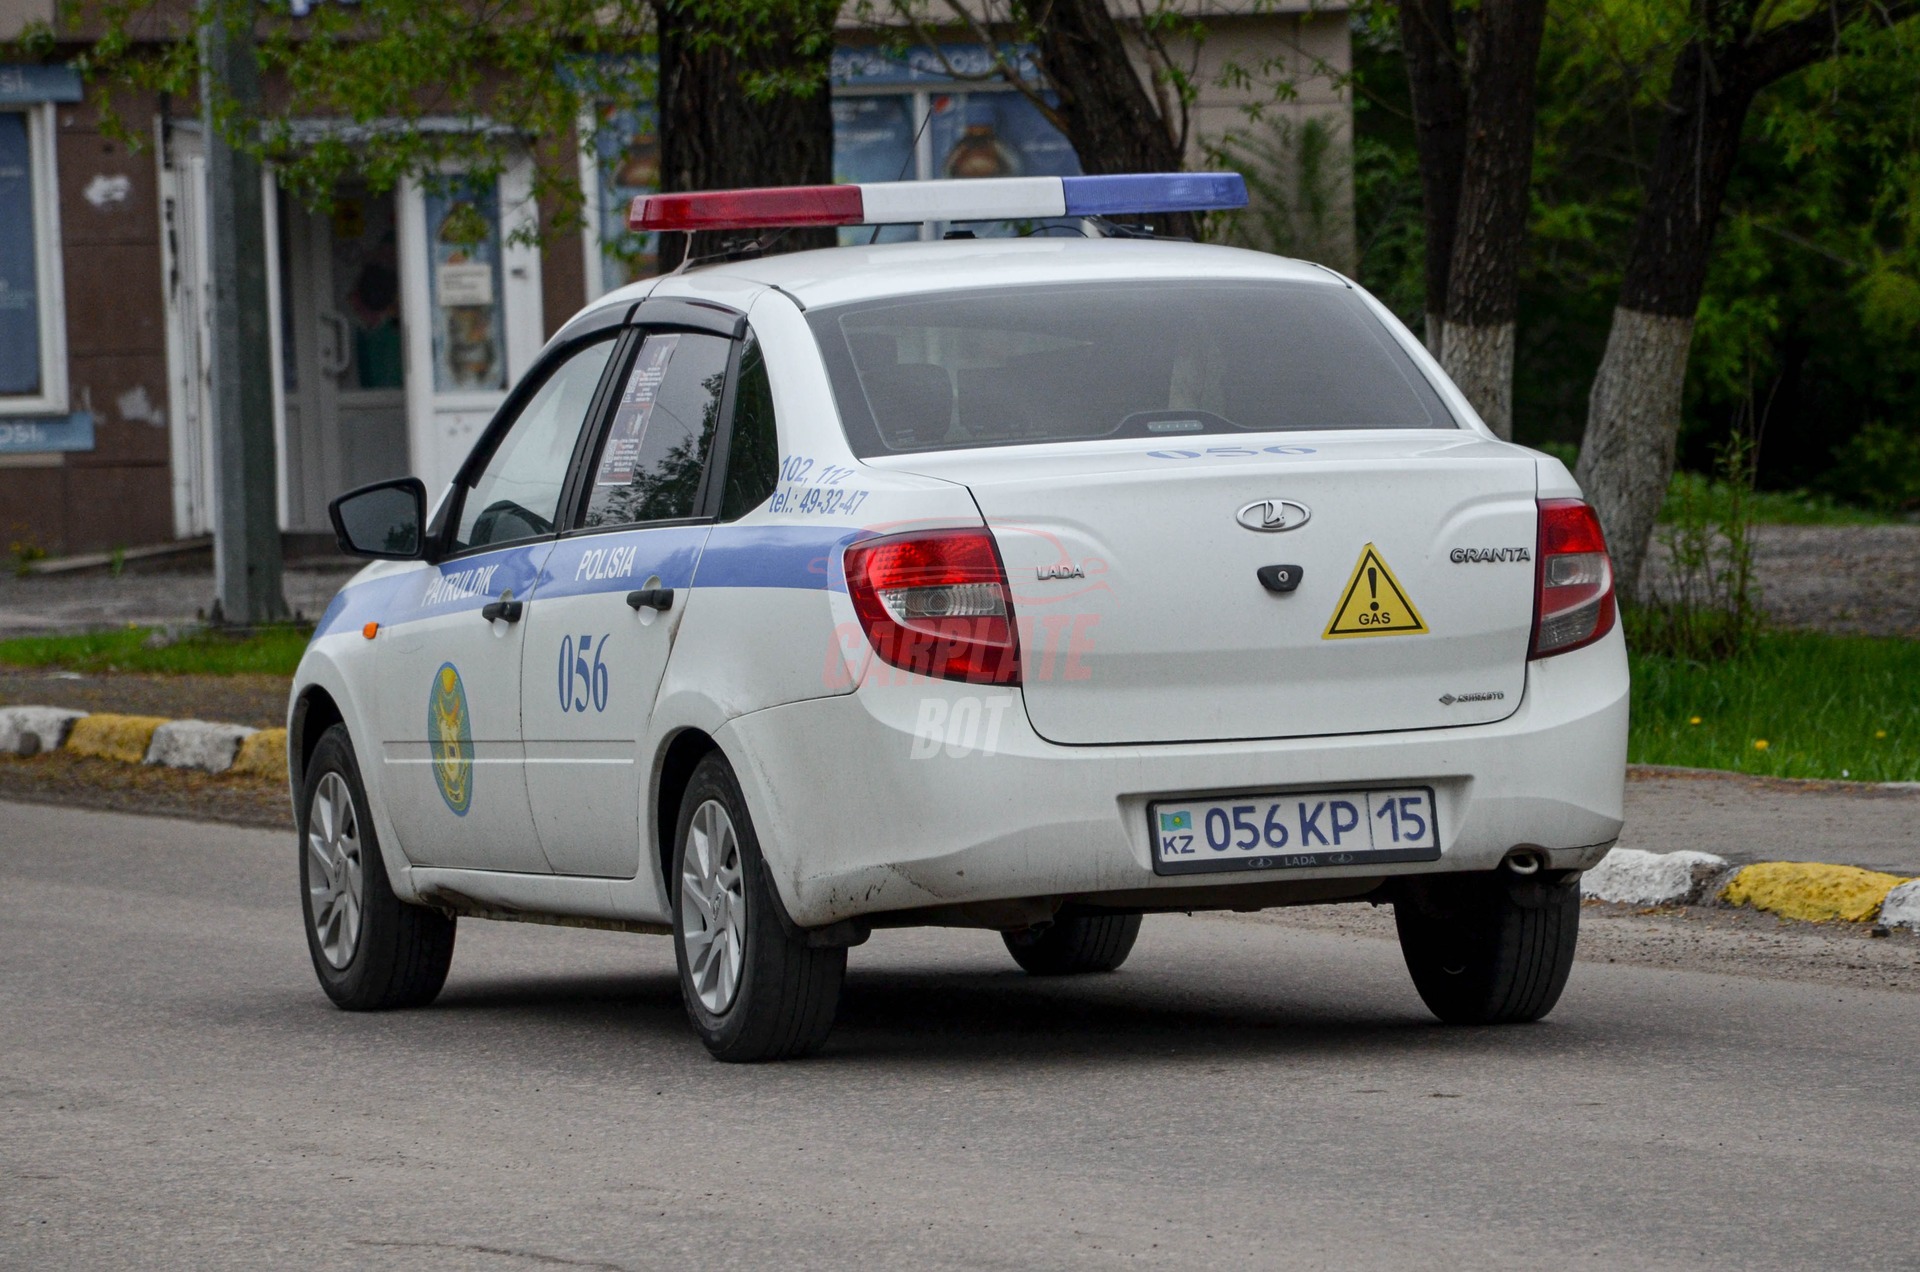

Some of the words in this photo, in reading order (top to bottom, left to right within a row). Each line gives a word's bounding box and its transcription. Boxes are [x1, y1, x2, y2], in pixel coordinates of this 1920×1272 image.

[1146, 444, 1318, 459] 056
[780, 454, 814, 486] 102,
[816, 464, 855, 484] 112
[799, 487, 870, 515] 49-32-47
[574, 545, 638, 582] POLISIA
[1450, 547, 1531, 564] GRANTA
[1036, 563, 1085, 580] LADA
[421, 564, 499, 607] PATRULDIK
[1358, 612, 1391, 625] GAS
[558, 633, 610, 713] 056
[1204, 804, 1289, 852] 056
[1299, 800, 1359, 847] KP
[1376, 796, 1426, 843] 15
[1162, 835, 1195, 855] KZ
[1285, 855, 1317, 866] LADA
